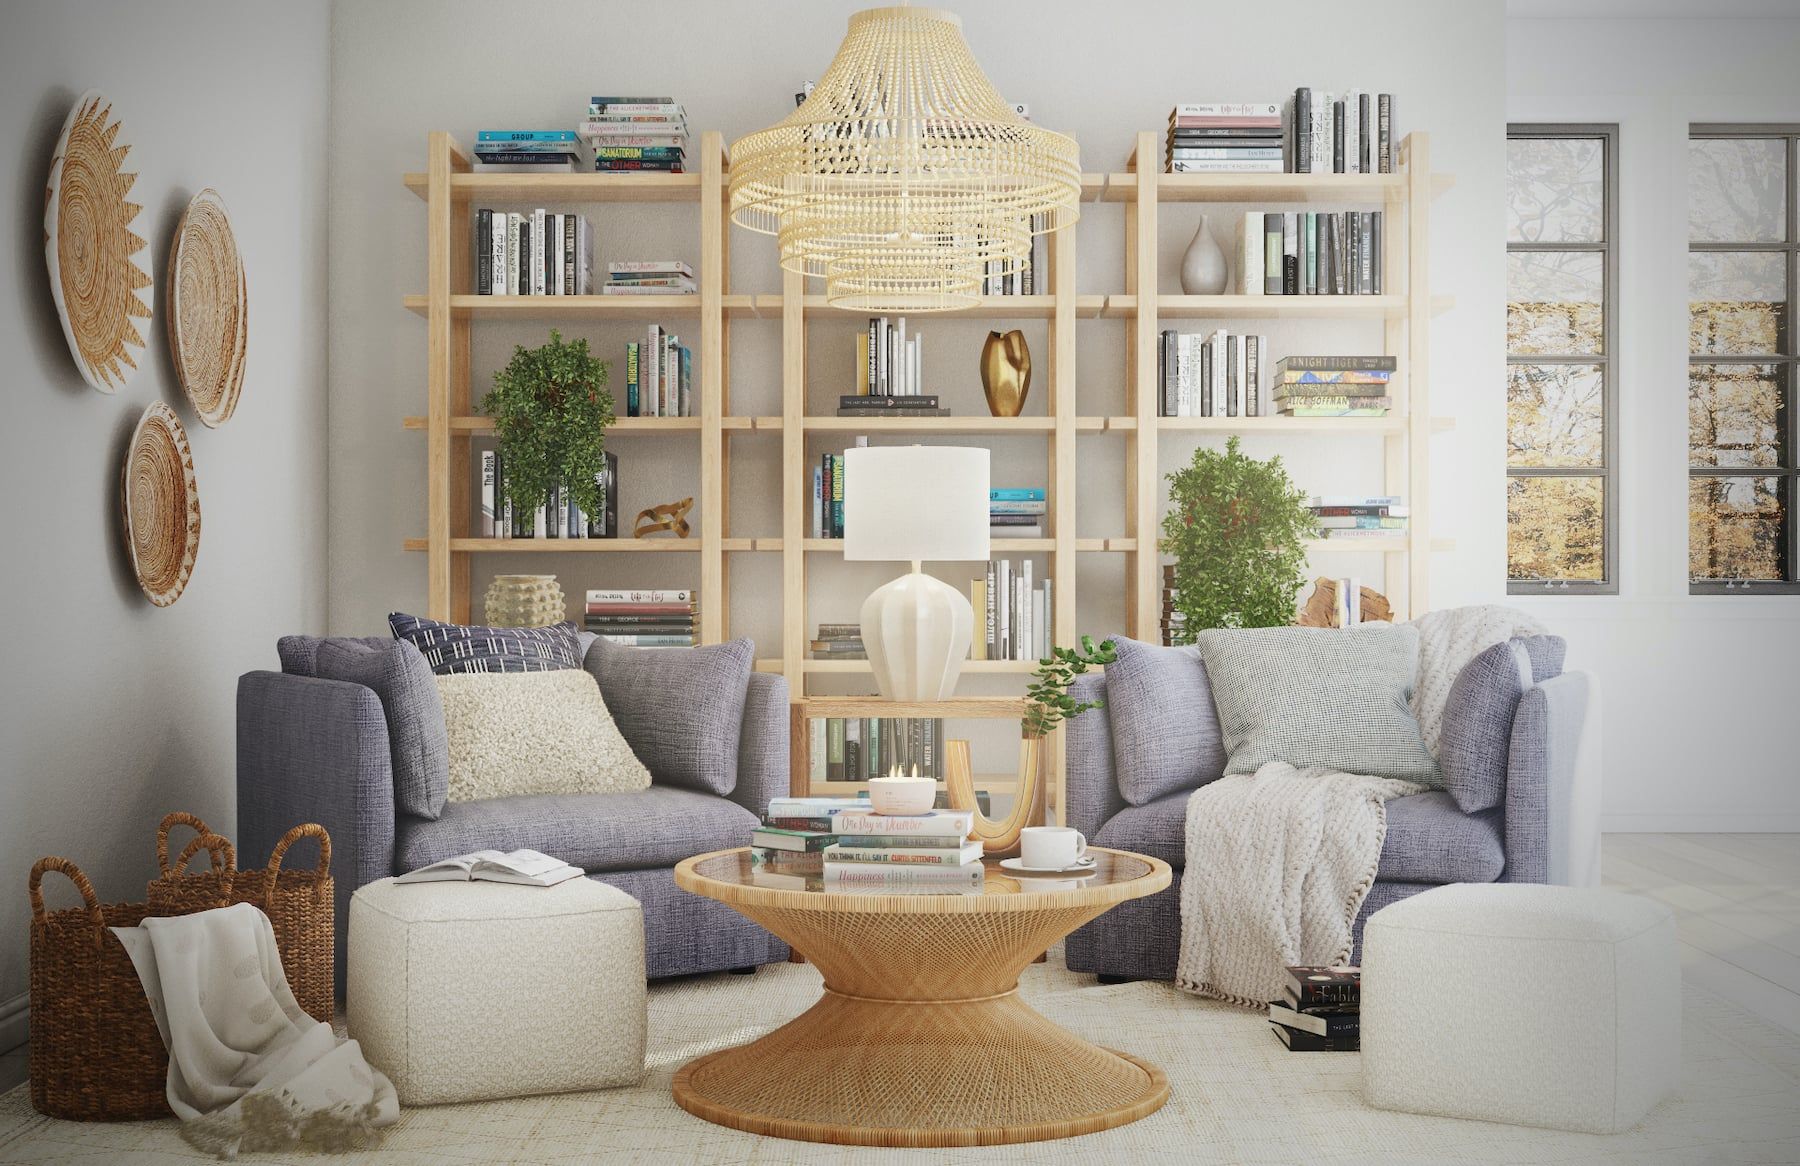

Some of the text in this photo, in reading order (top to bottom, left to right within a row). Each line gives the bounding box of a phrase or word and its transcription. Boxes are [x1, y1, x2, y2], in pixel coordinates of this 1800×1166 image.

[602, 147, 642, 158] SANATORIUM
[611, 160, 641, 169] OTHER
[627, 350, 638, 385] SANATORIUM
[1298, 358, 1328, 368] NIGHT
[1331, 358, 1358, 368] TIGER
[1311, 396, 1348, 406] HOFFMAN
[484, 455, 494, 487] The Book
[833, 462, 844, 501] SANATORIUM
[987, 572, 995, 609] ИРВИН
[924, 746, 932, 767] WATER
[842, 816, 857, 831] One
[858, 815, 875, 833] Day
[884, 816, 922, 832] December
[828, 852, 838, 860] YOU
[839, 852, 855, 861] THINK
[872, 853, 882, 861] SAY
[882, 854, 888, 862] IT
[839, 870, 885, 882] Happiness
